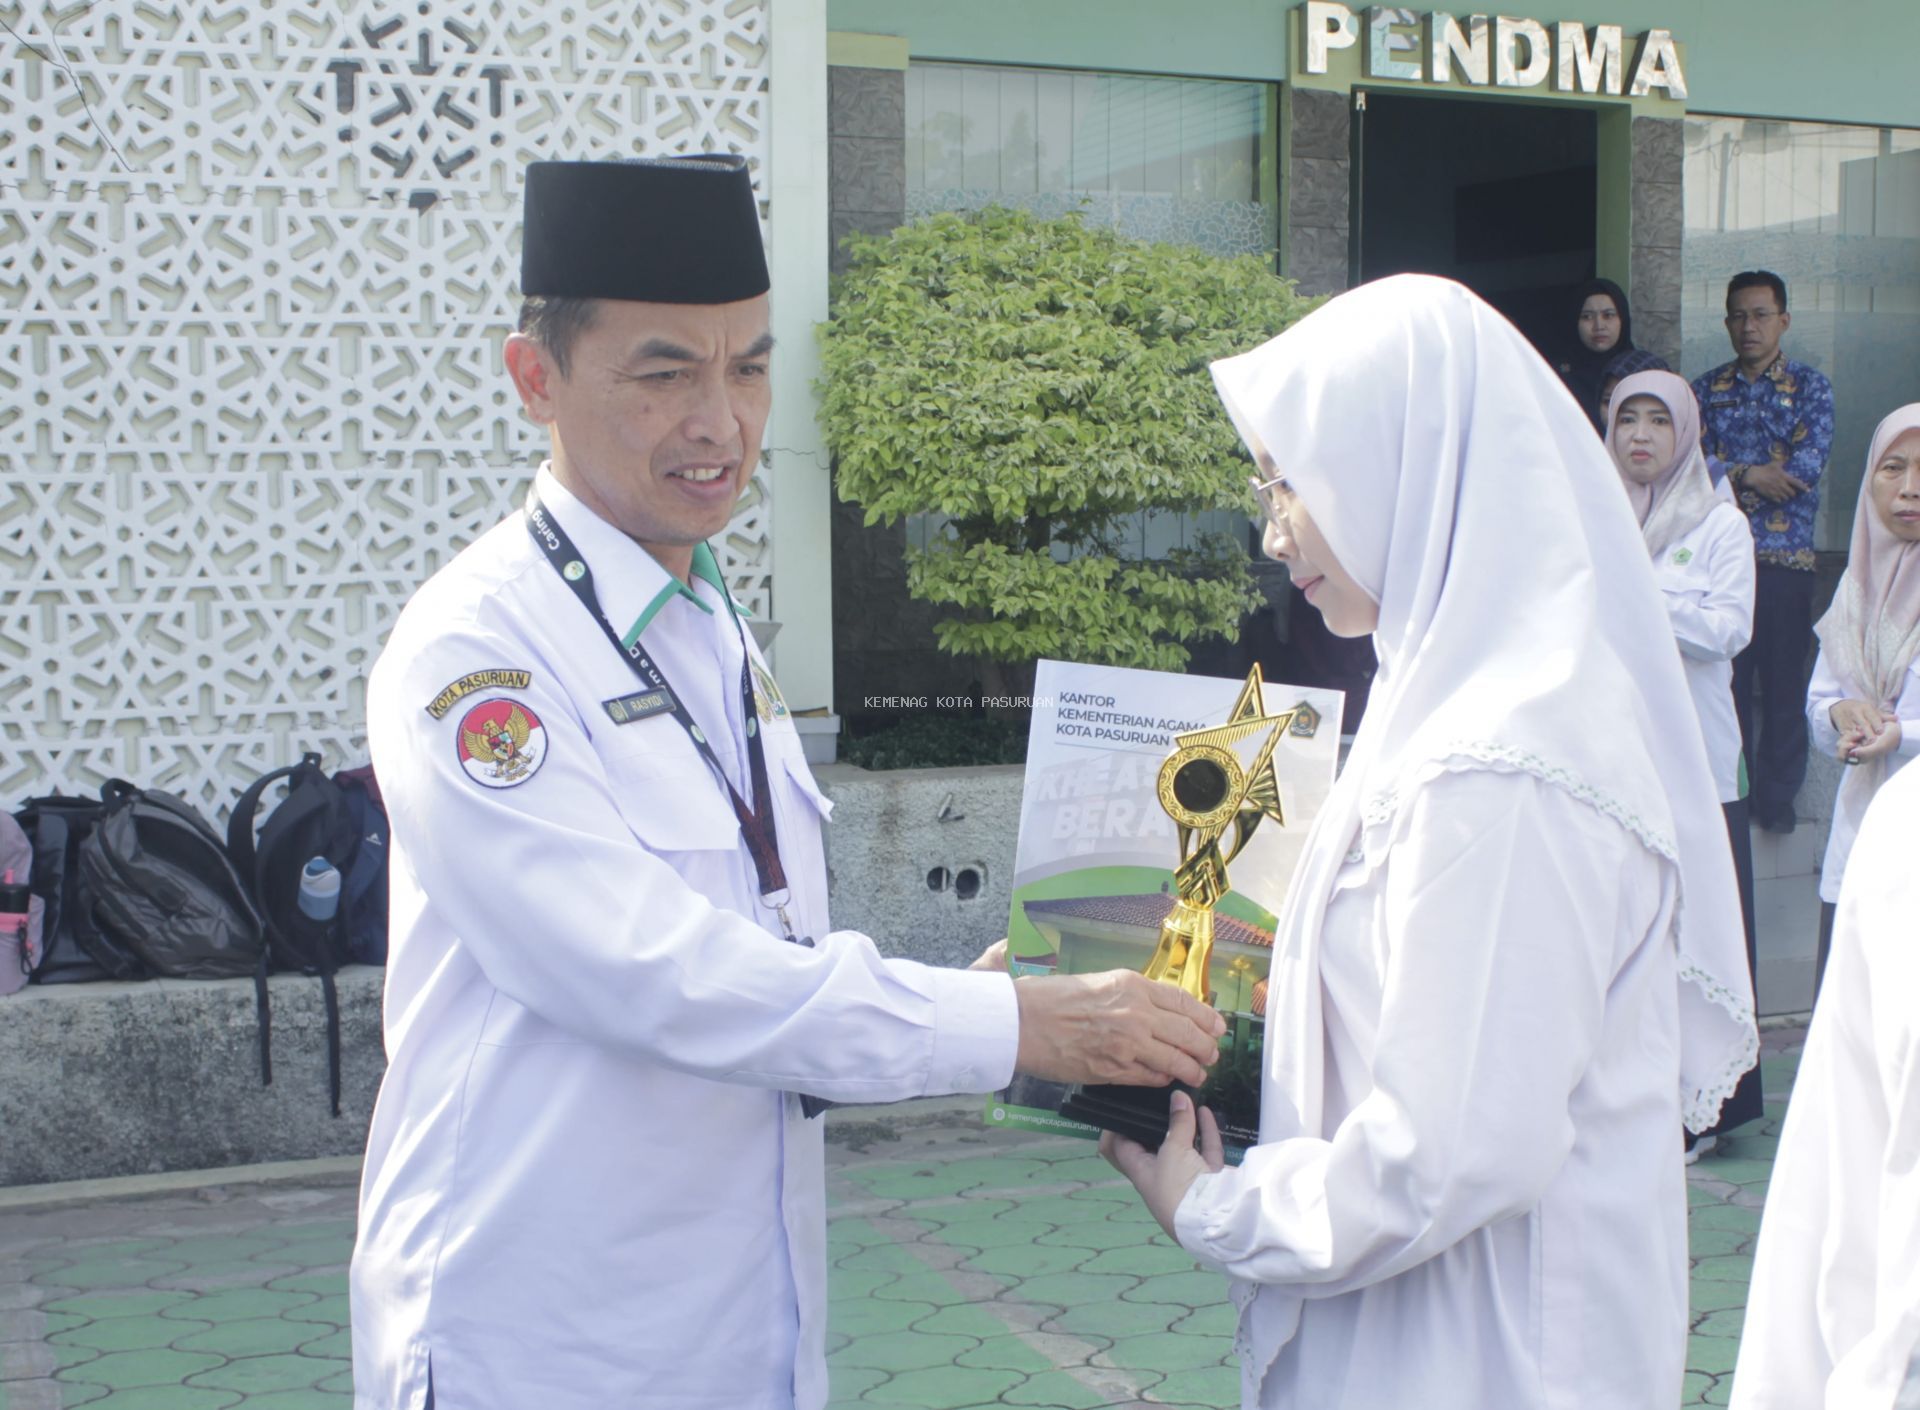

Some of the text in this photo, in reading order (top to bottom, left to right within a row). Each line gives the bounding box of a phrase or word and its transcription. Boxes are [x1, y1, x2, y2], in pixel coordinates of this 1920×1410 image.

[1303, 0, 1688, 99] PENDMA
[531, 509, 560, 551] Caring
[431, 671, 525, 714] KOTA PASURUAN
[1059, 691, 1116, 708] KANTOR
[1057, 707, 1155, 729] KEMENTERIAN
[1056, 723, 1170, 746] KOTA PASURUAN
